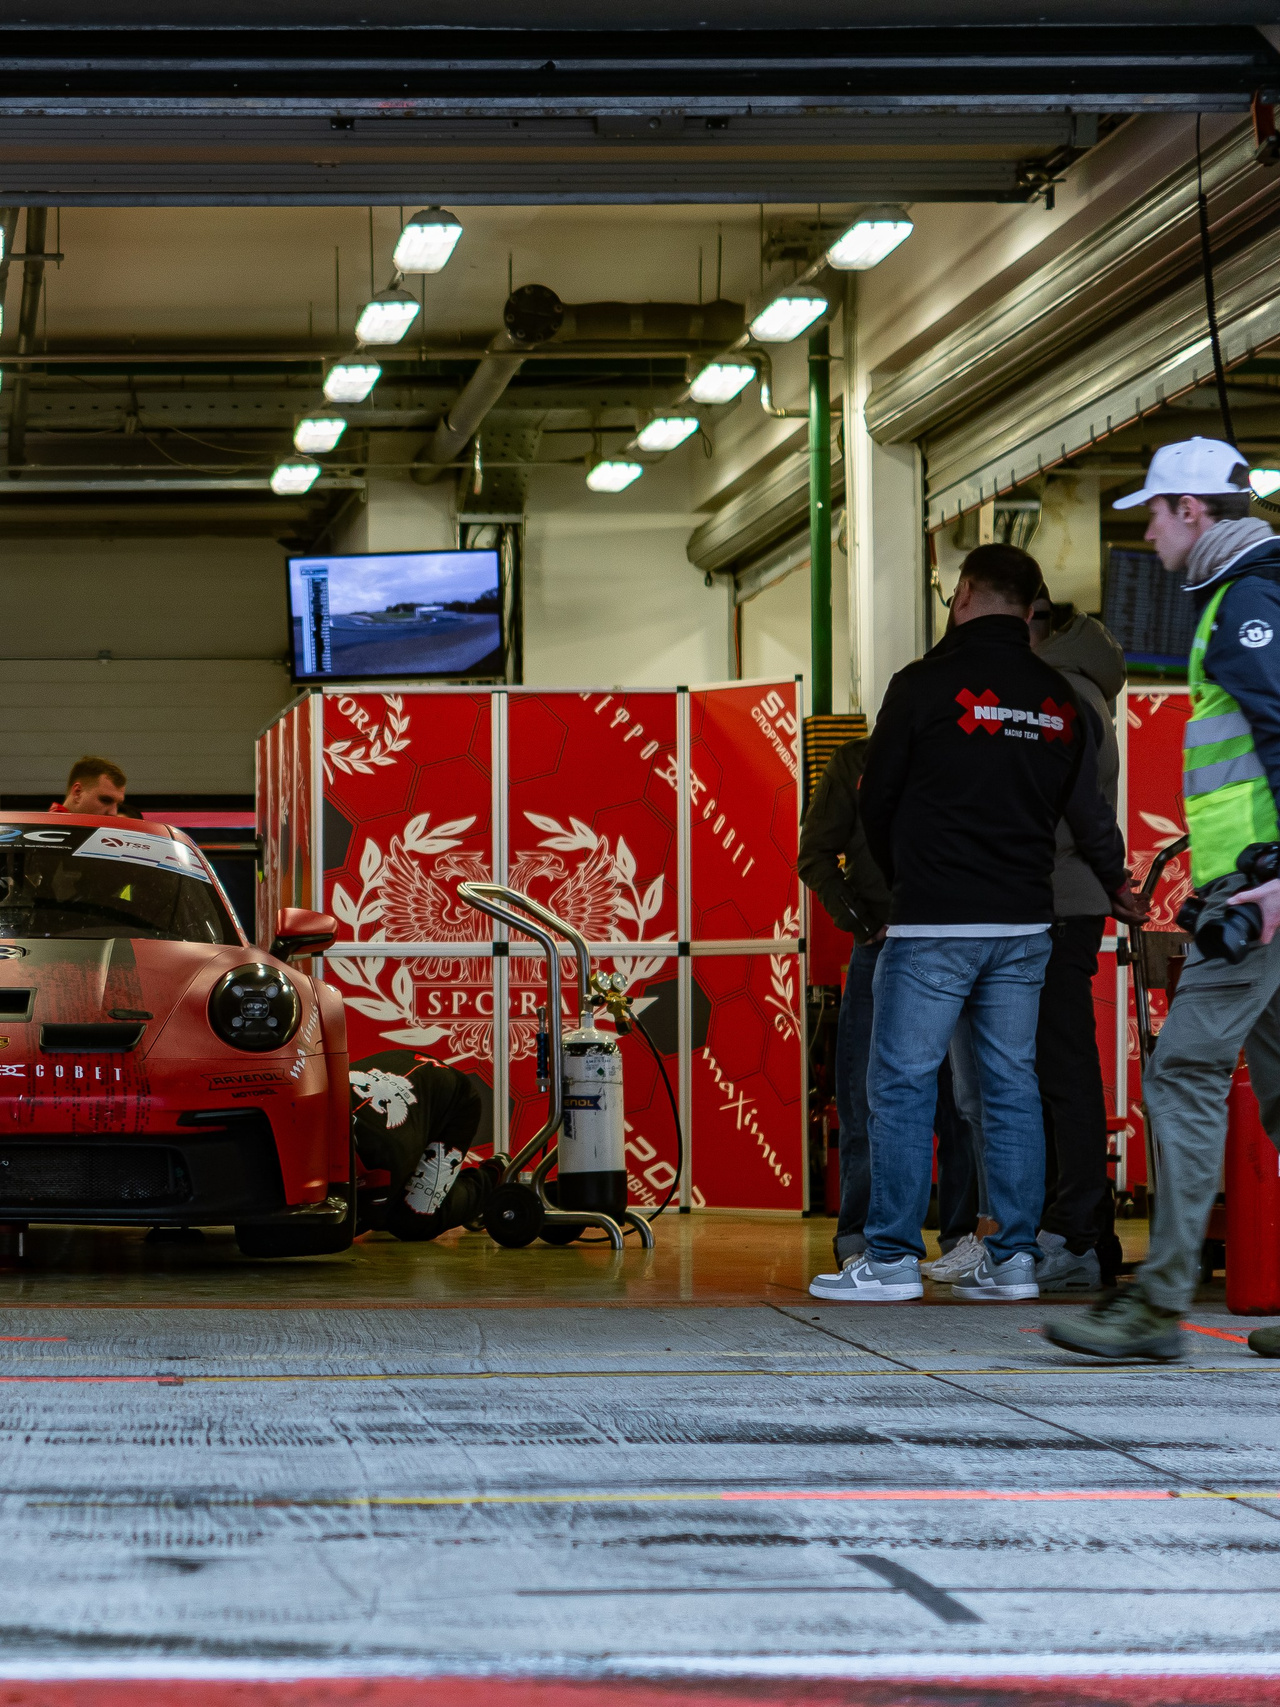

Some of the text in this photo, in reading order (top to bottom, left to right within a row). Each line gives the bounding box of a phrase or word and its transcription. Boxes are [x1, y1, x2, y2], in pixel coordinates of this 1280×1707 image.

[326, 693, 380, 743] ORA
[973, 705, 1064, 731] NIPPLES
[1024, 731, 1039, 740] TEAM
[125, 841, 151, 850] TSS
[773, 1013, 795, 1042] GT
[35, 1064, 122, 1081] СОВЕТ
